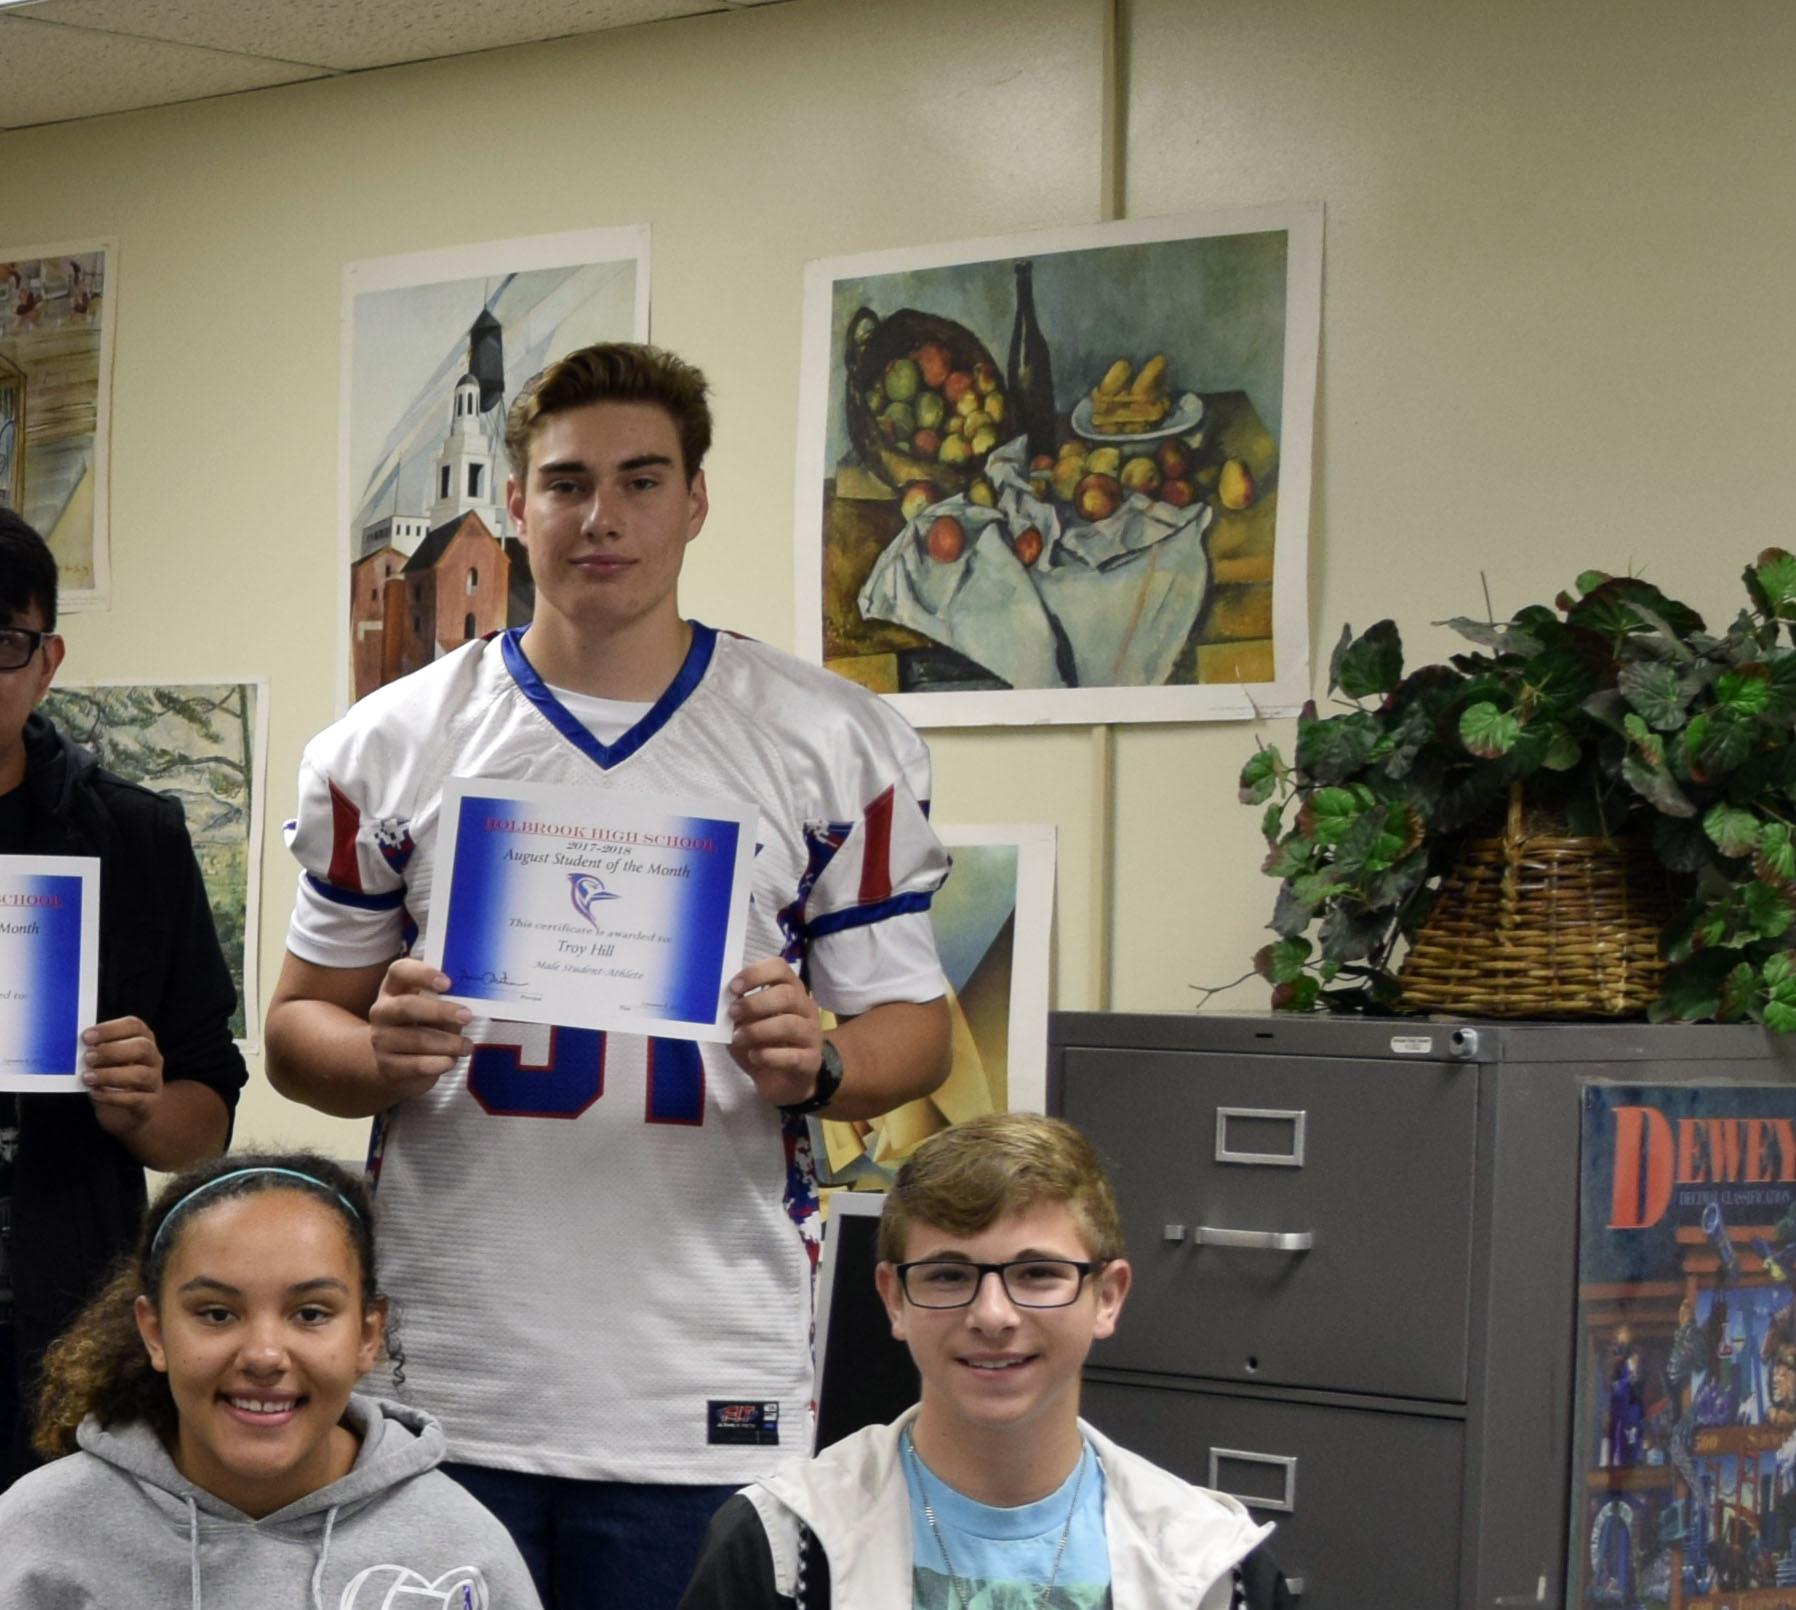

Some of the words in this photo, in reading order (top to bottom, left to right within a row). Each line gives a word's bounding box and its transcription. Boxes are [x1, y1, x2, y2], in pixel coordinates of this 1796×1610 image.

[565, 839, 632, 856] 2017-2018
[590, 827, 638, 843] HIGH
[642, 832, 716, 851] SCHOOL
[501, 846, 550, 868] August
[552, 851, 603, 869] Student
[604, 856, 622, 875] of
[622, 858, 644, 873] the
[645, 860, 692, 878] Month
[556, 938, 588, 958] Troy
[589, 942, 616, 958] Hill
